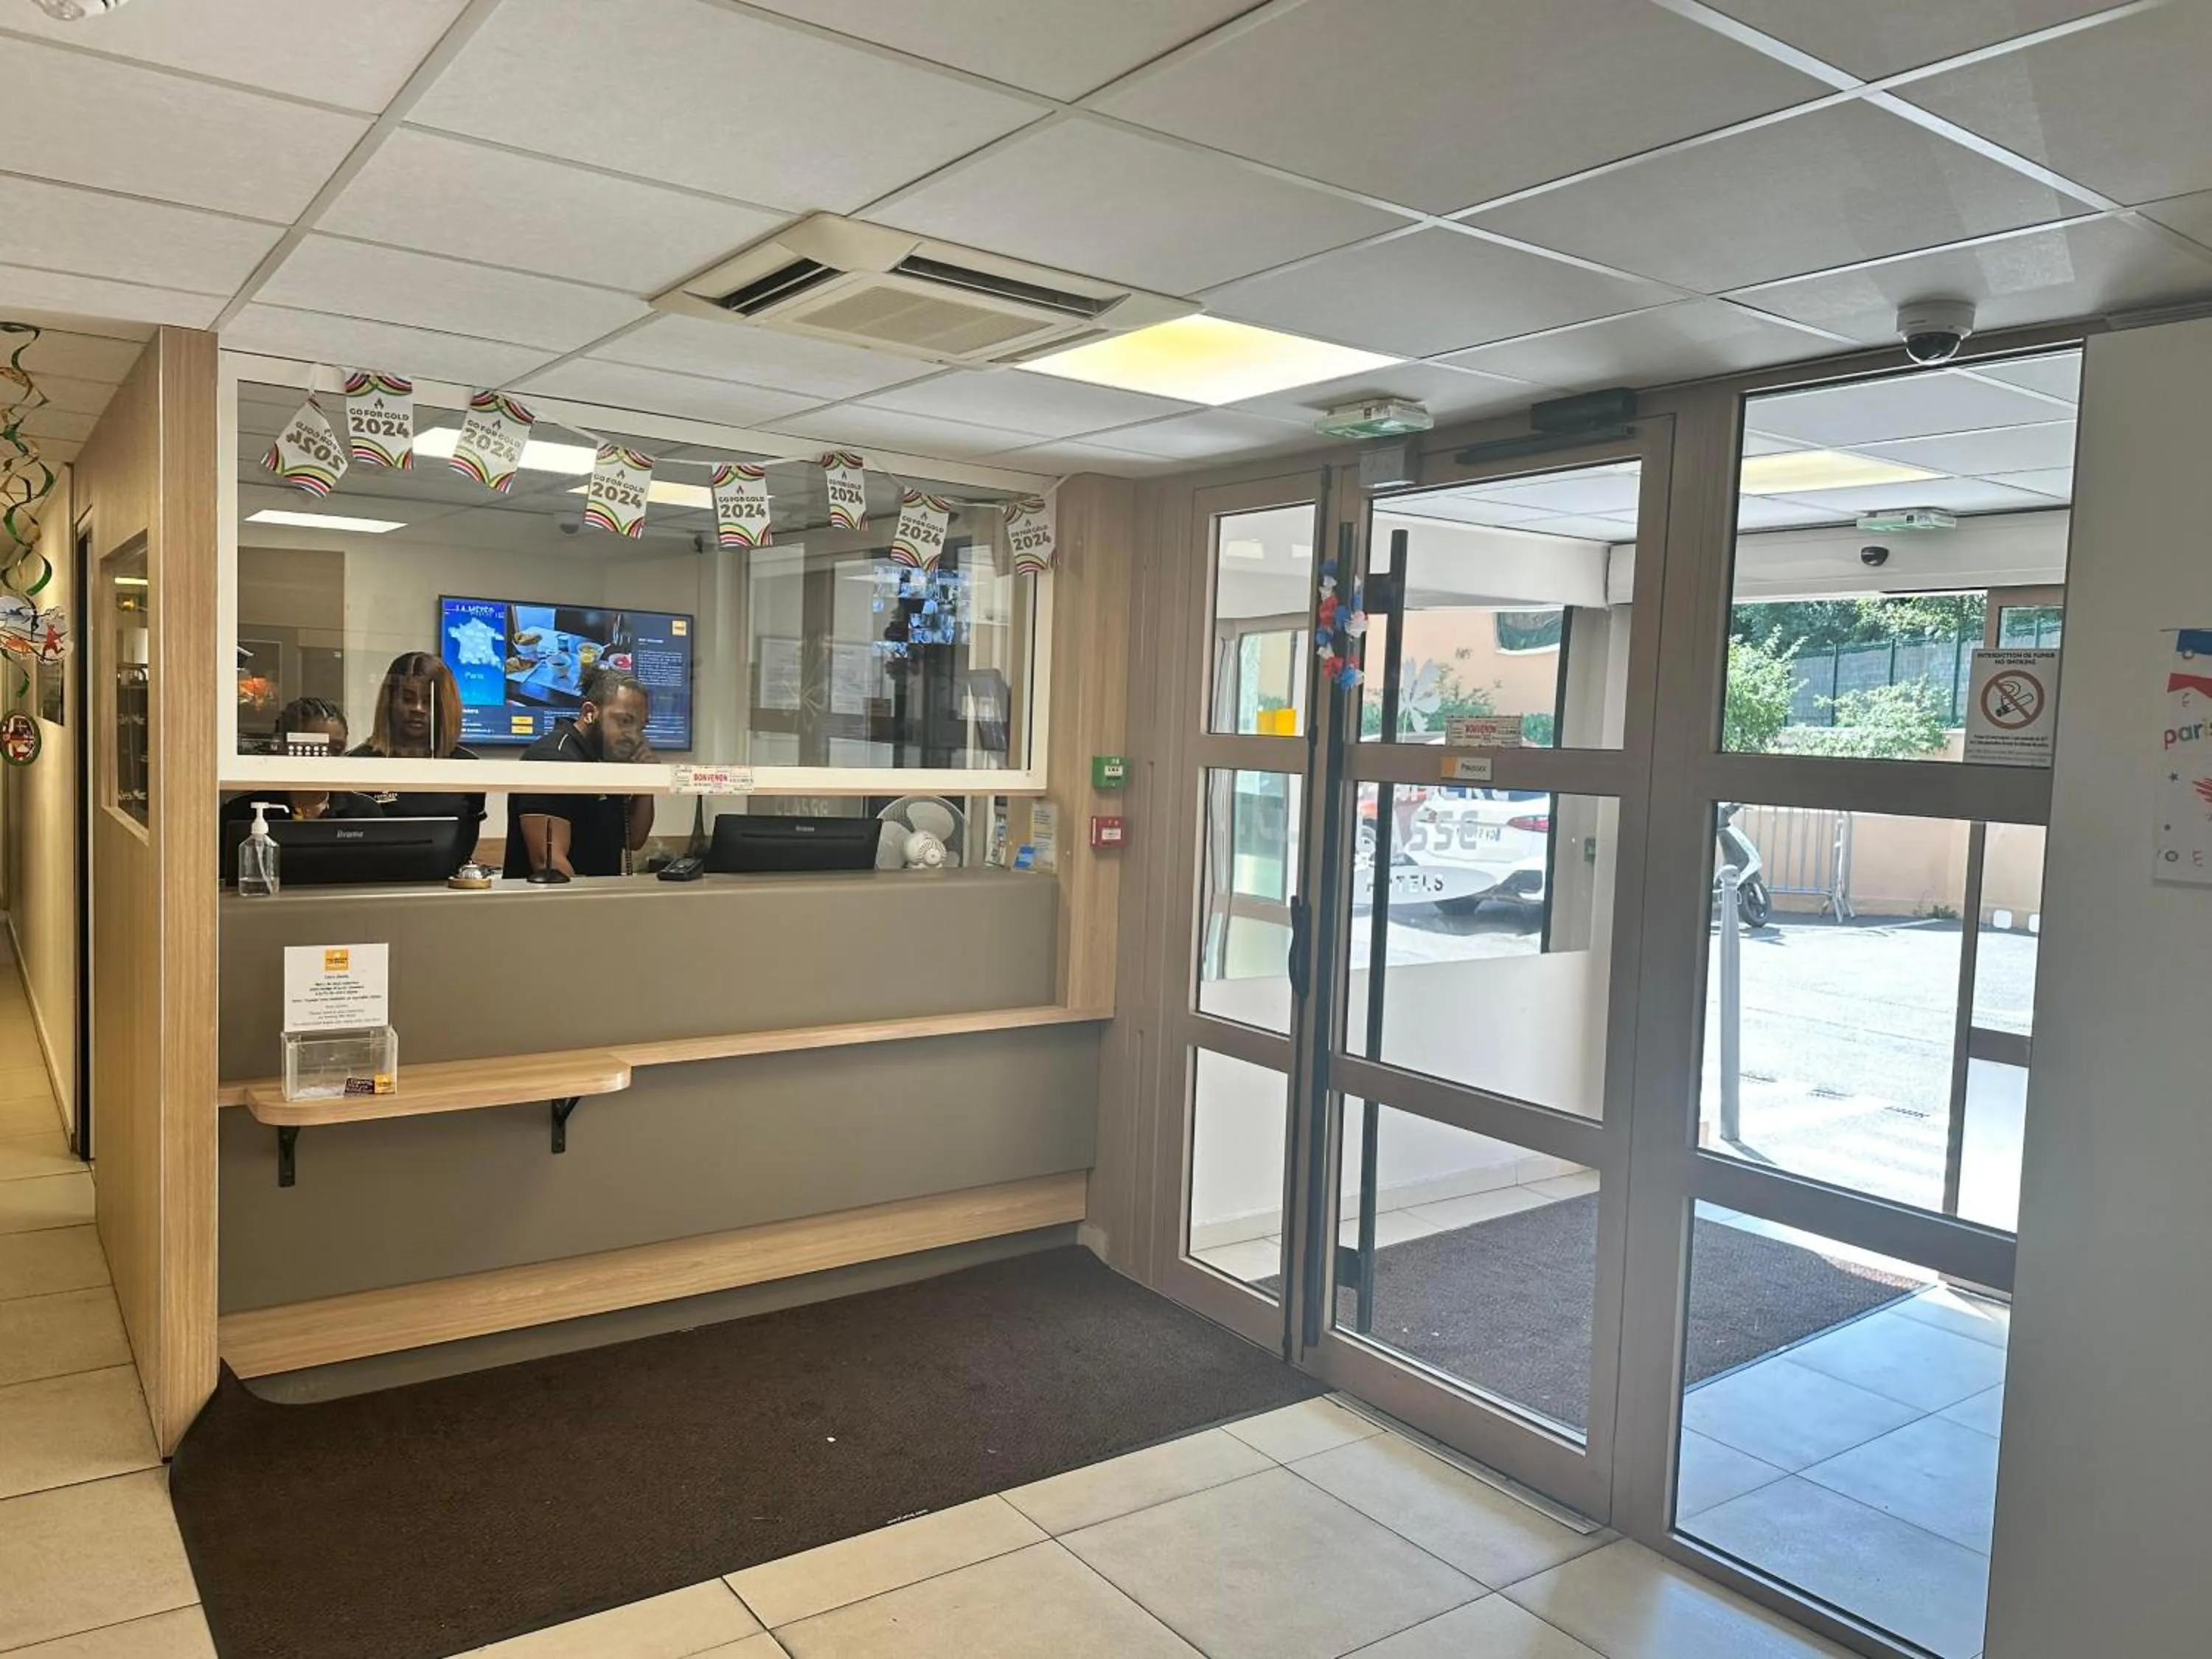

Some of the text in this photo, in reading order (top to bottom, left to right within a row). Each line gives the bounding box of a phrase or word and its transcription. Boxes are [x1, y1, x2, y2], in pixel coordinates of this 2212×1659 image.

[364, 409, 383, 418] FOR
[384, 411, 409, 420] GOLD
[350, 417, 409, 438] 2024
[463, 427, 515, 462] 2024
[591, 481, 642, 509] 2024
[830, 488, 863, 504] 2024
[720, 504, 766, 518] 2024
[899, 523, 941, 546] 2024
[1012, 532, 1051, 551] 2024
